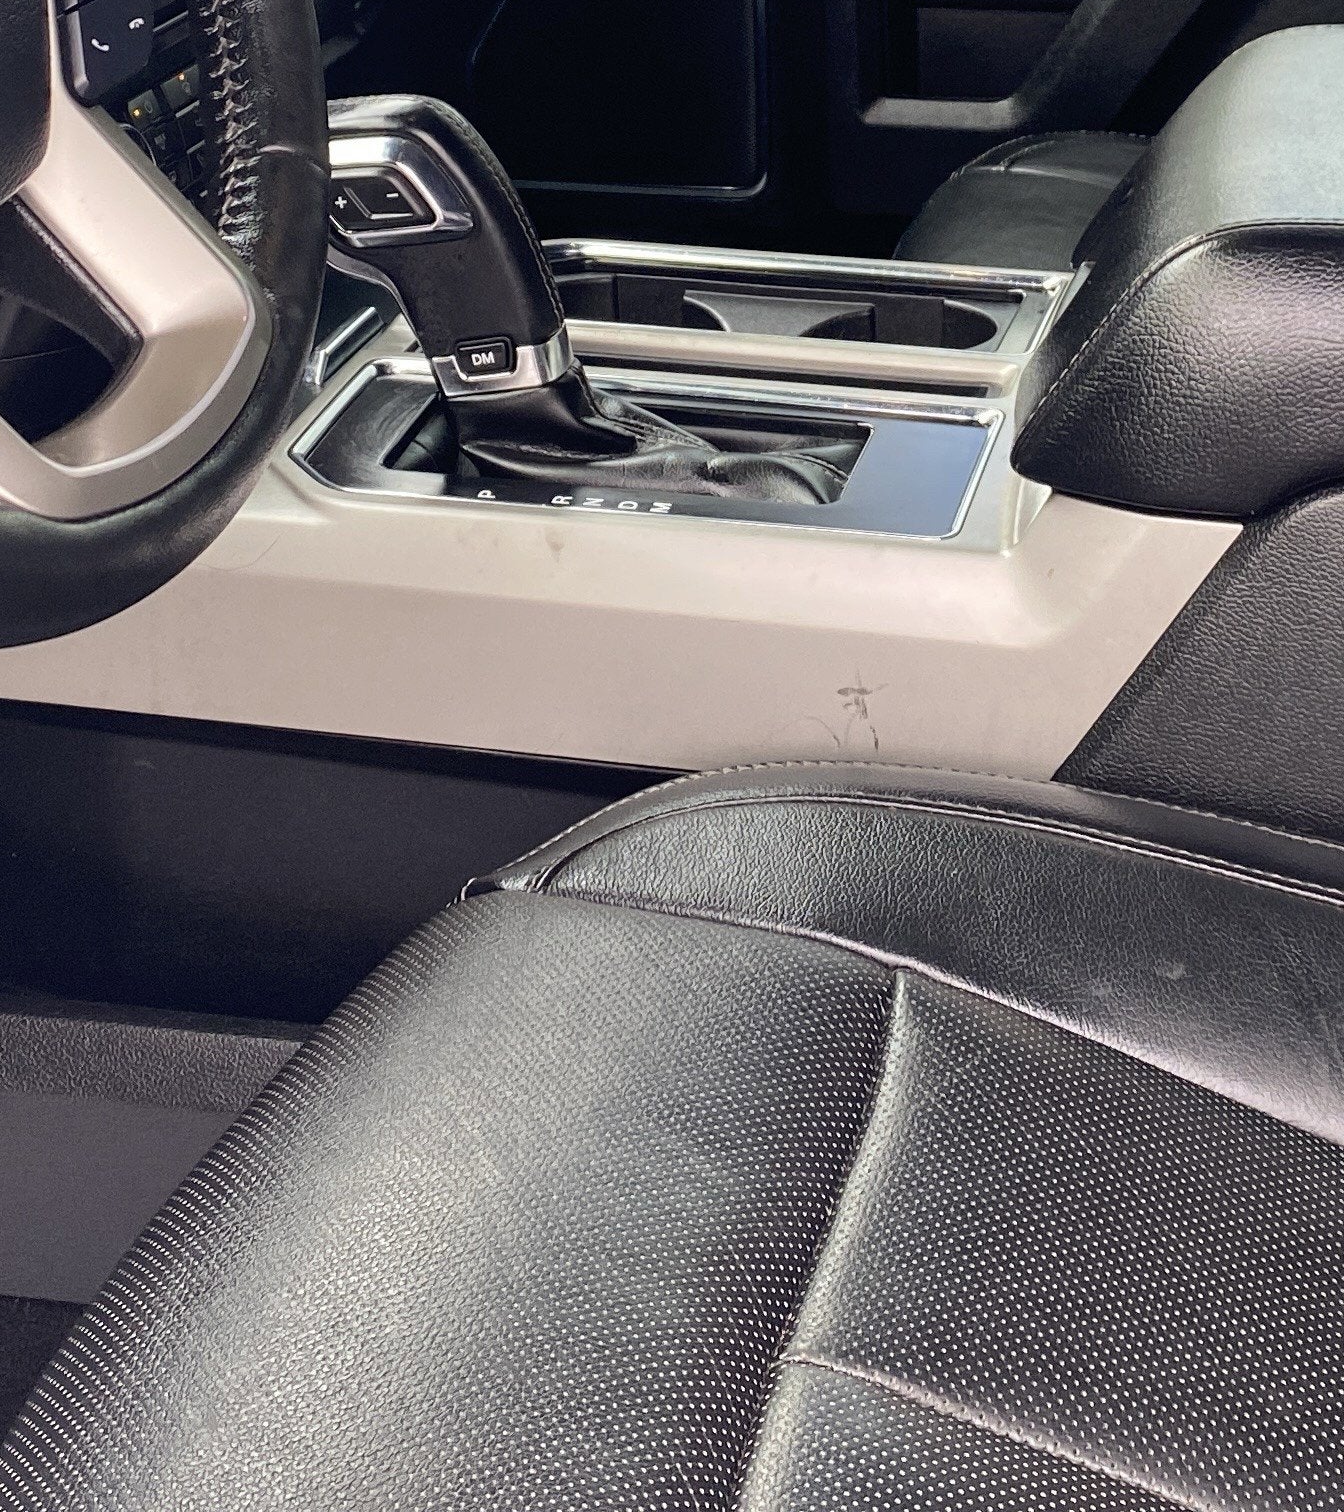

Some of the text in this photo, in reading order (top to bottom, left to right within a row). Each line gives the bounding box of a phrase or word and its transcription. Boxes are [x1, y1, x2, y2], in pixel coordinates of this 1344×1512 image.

[471, 351, 495, 366] DM
[477, 489, 496, 499] P
[551, 495, 573, 505] R
[618, 500, 639, 510] D
[649, 501, 673, 513] M
